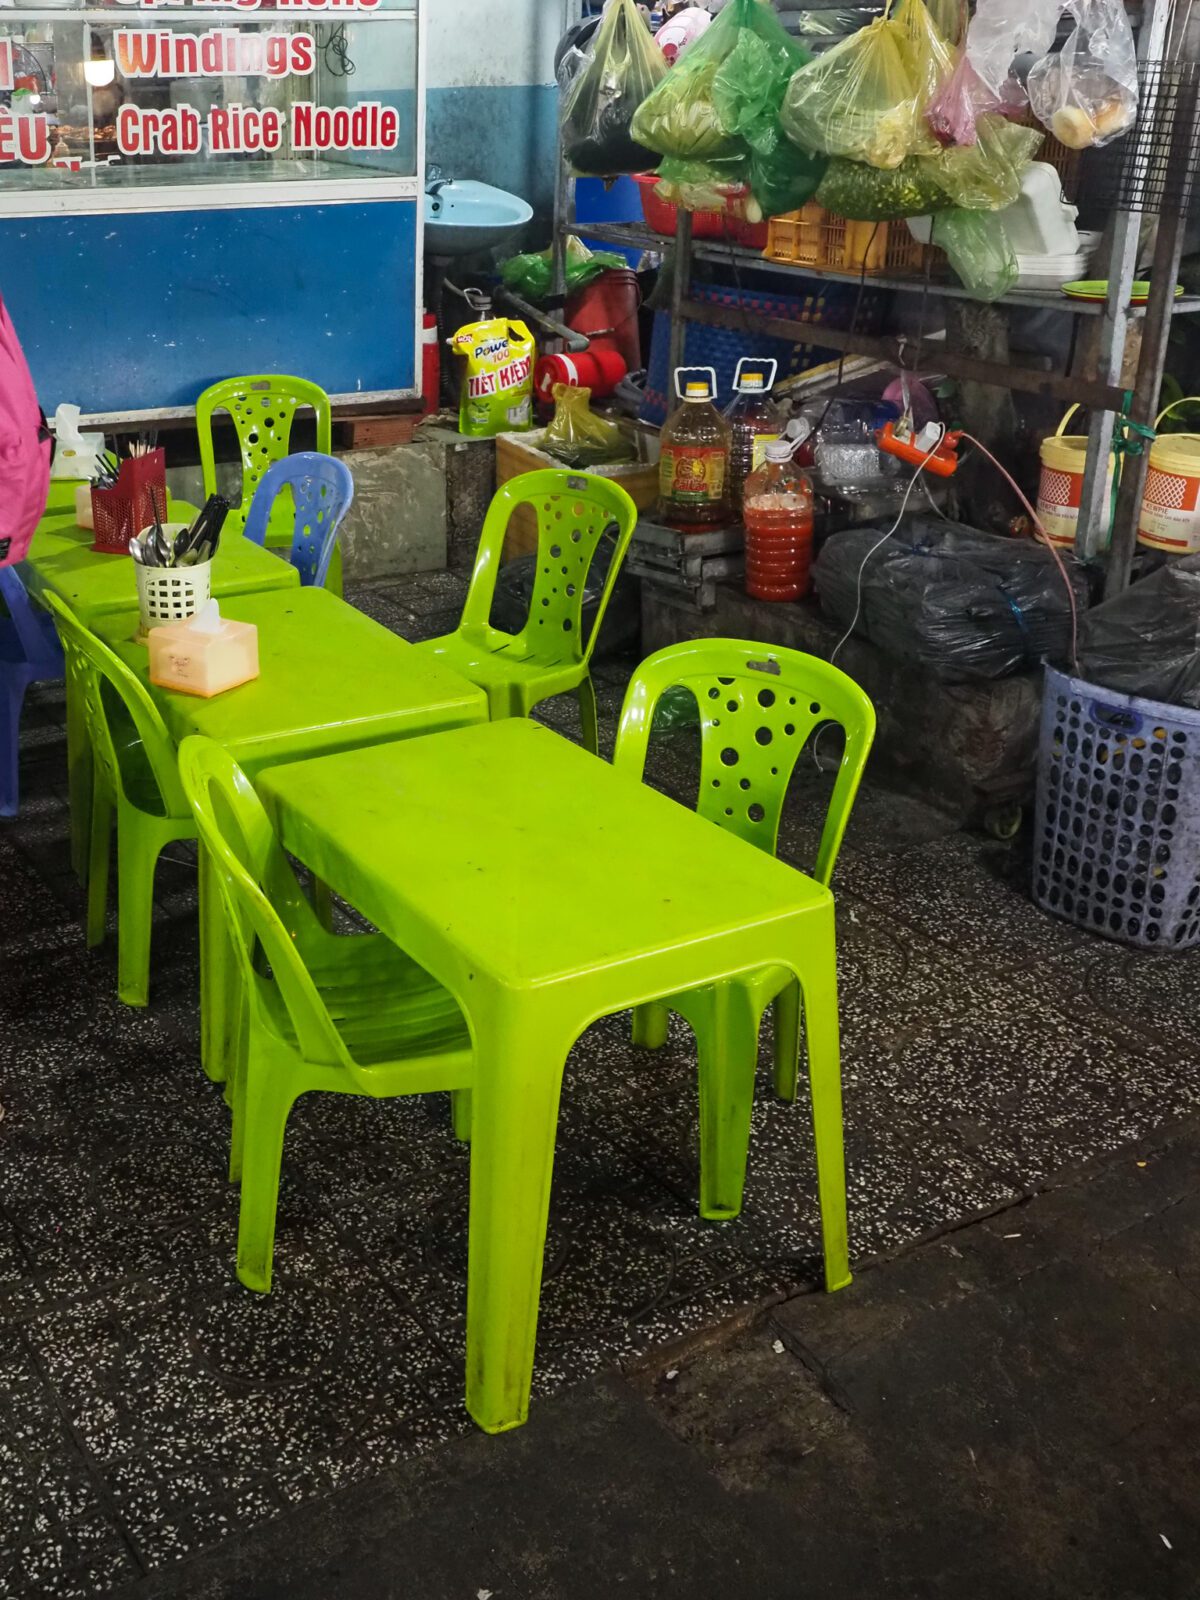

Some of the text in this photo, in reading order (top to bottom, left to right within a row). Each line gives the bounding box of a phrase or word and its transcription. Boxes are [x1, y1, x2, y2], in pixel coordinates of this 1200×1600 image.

[116, 31, 313, 76] Windings
[119, 104, 397, 152] Crab Rice Noodle
[475, 340, 509, 358] Powe
[492, 348, 510, 363] 100
